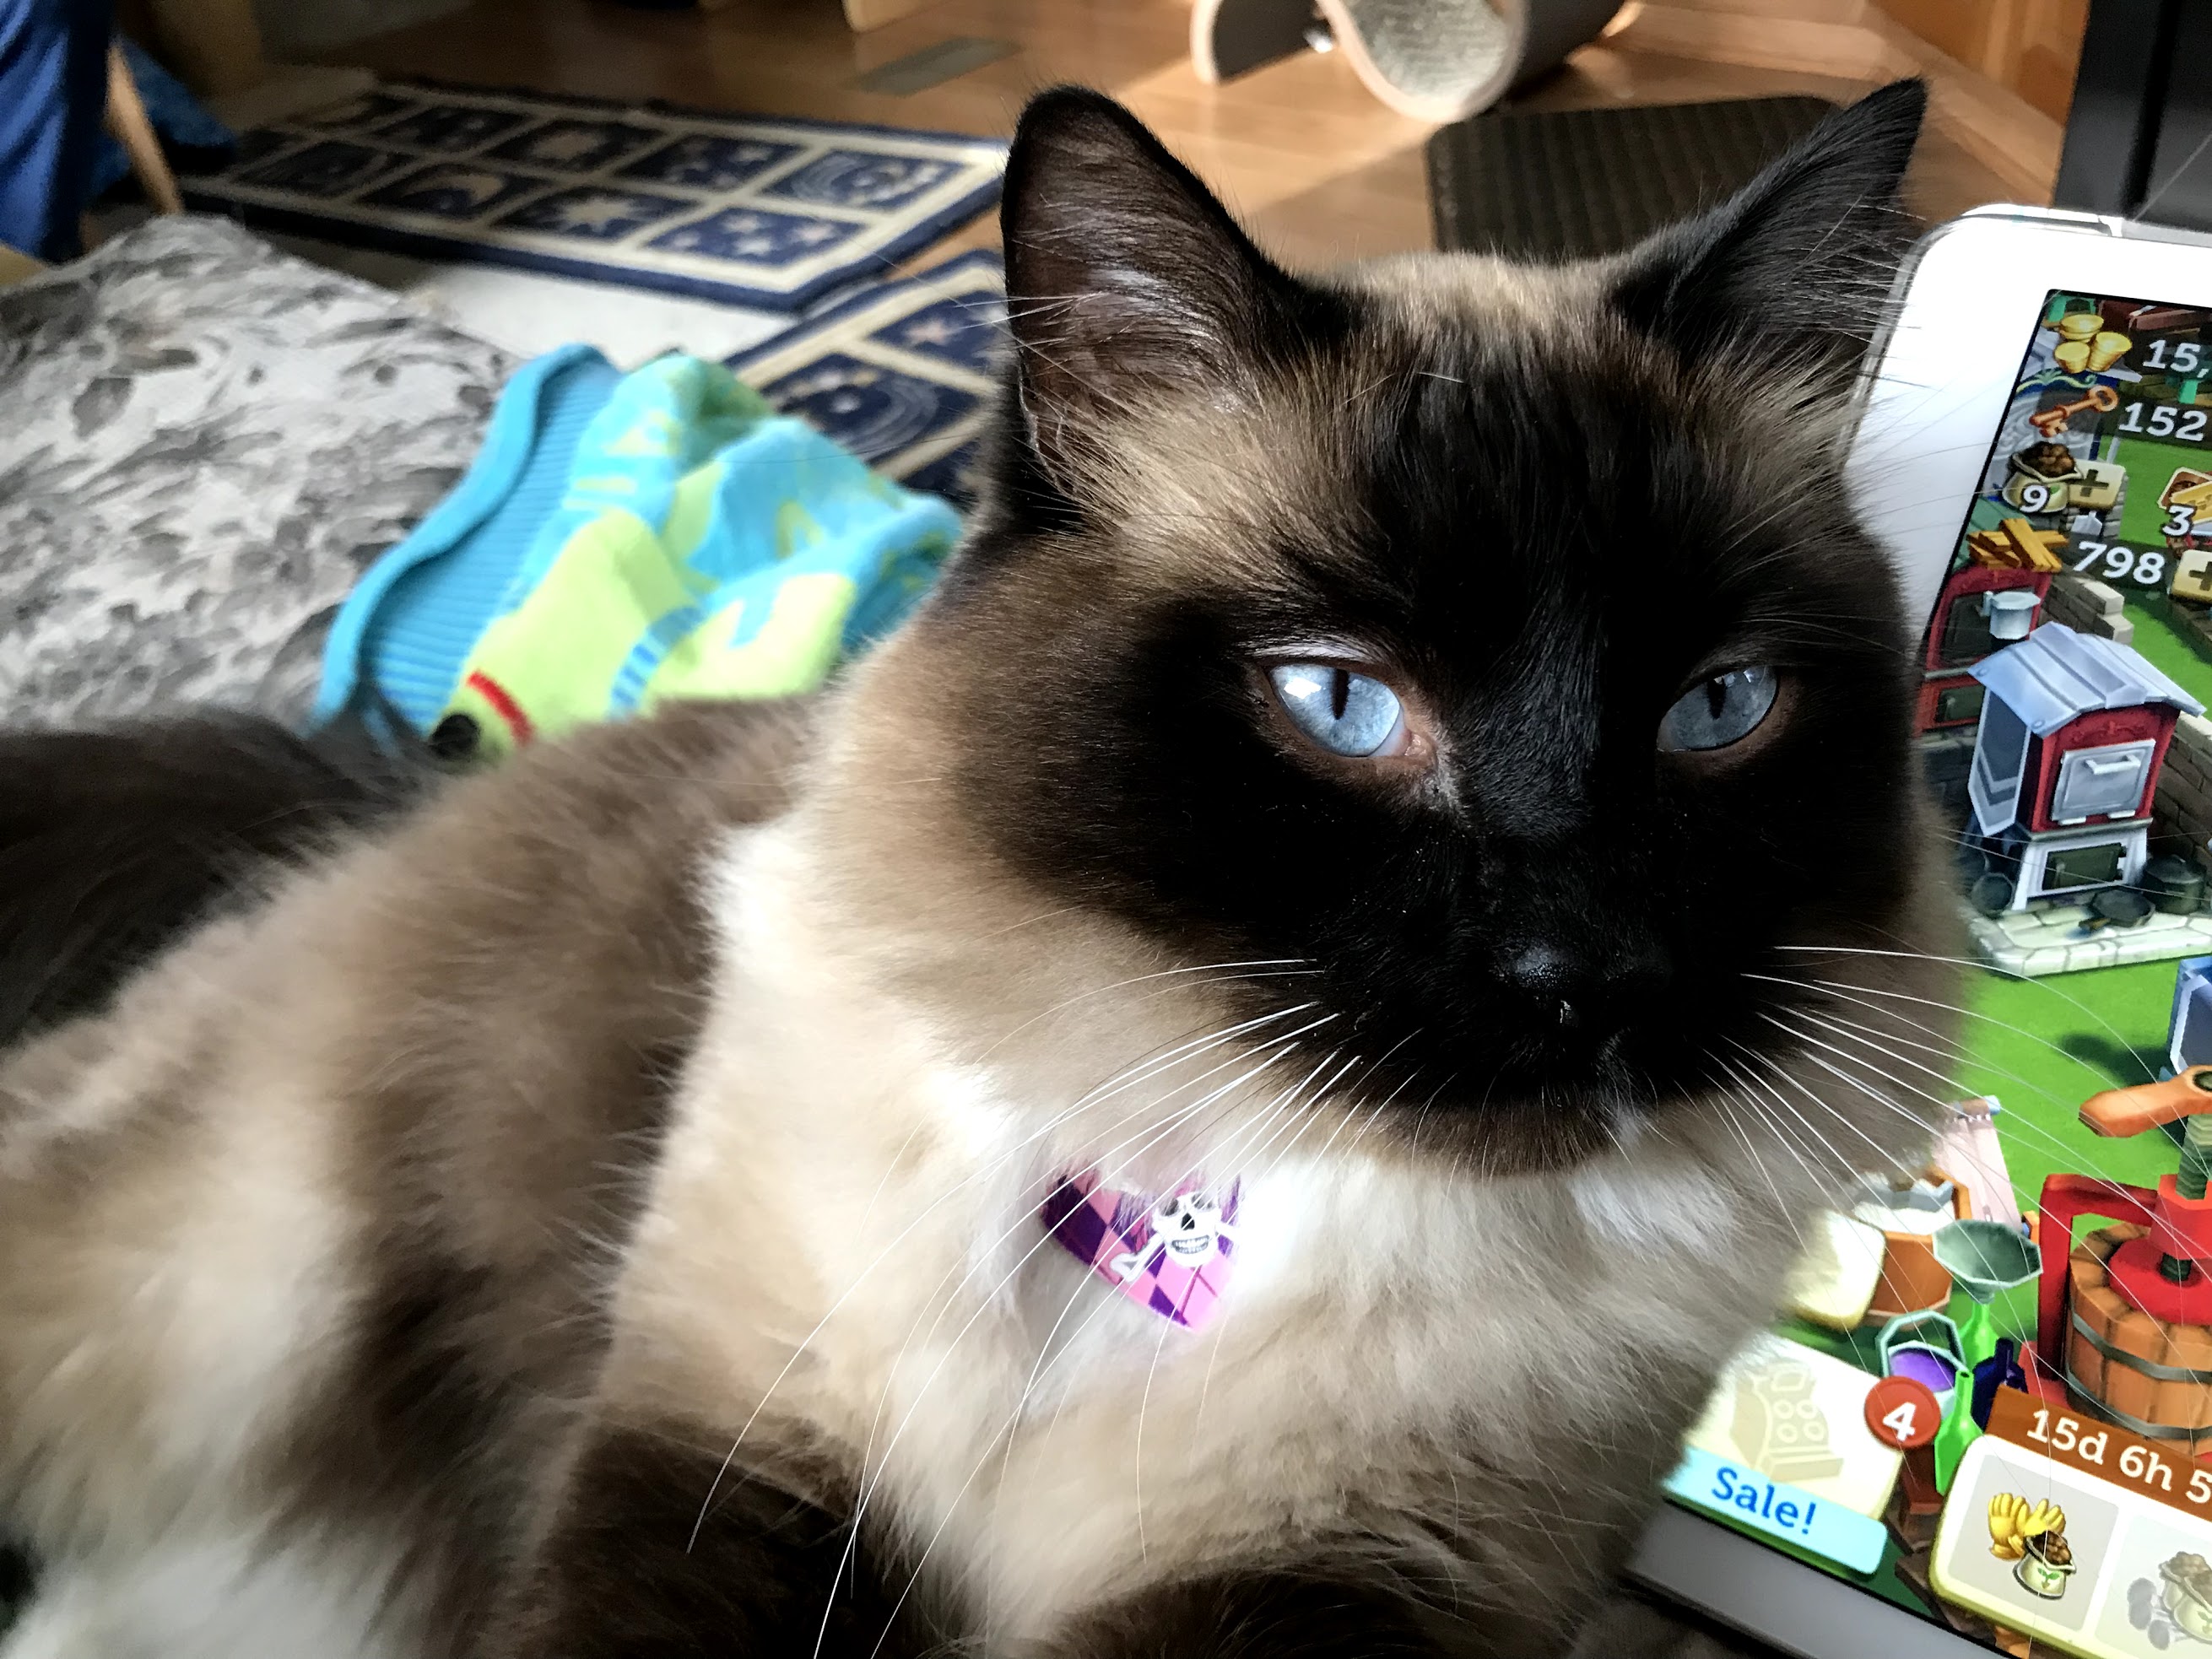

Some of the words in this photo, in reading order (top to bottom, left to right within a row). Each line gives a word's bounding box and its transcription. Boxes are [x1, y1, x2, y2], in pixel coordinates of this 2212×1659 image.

[2119, 402, 2207, 441] 152
[2020, 485, 2048, 513] 9
[2162, 506, 2193, 536] 3
[2073, 541, 2166, 585] 798
[1882, 1401, 1917, 1442] 4
[2027, 1408, 2108, 1466] 15d
[2119, 1445, 2173, 1492] 6h
[1712, 1467, 1816, 1535] Sale!
